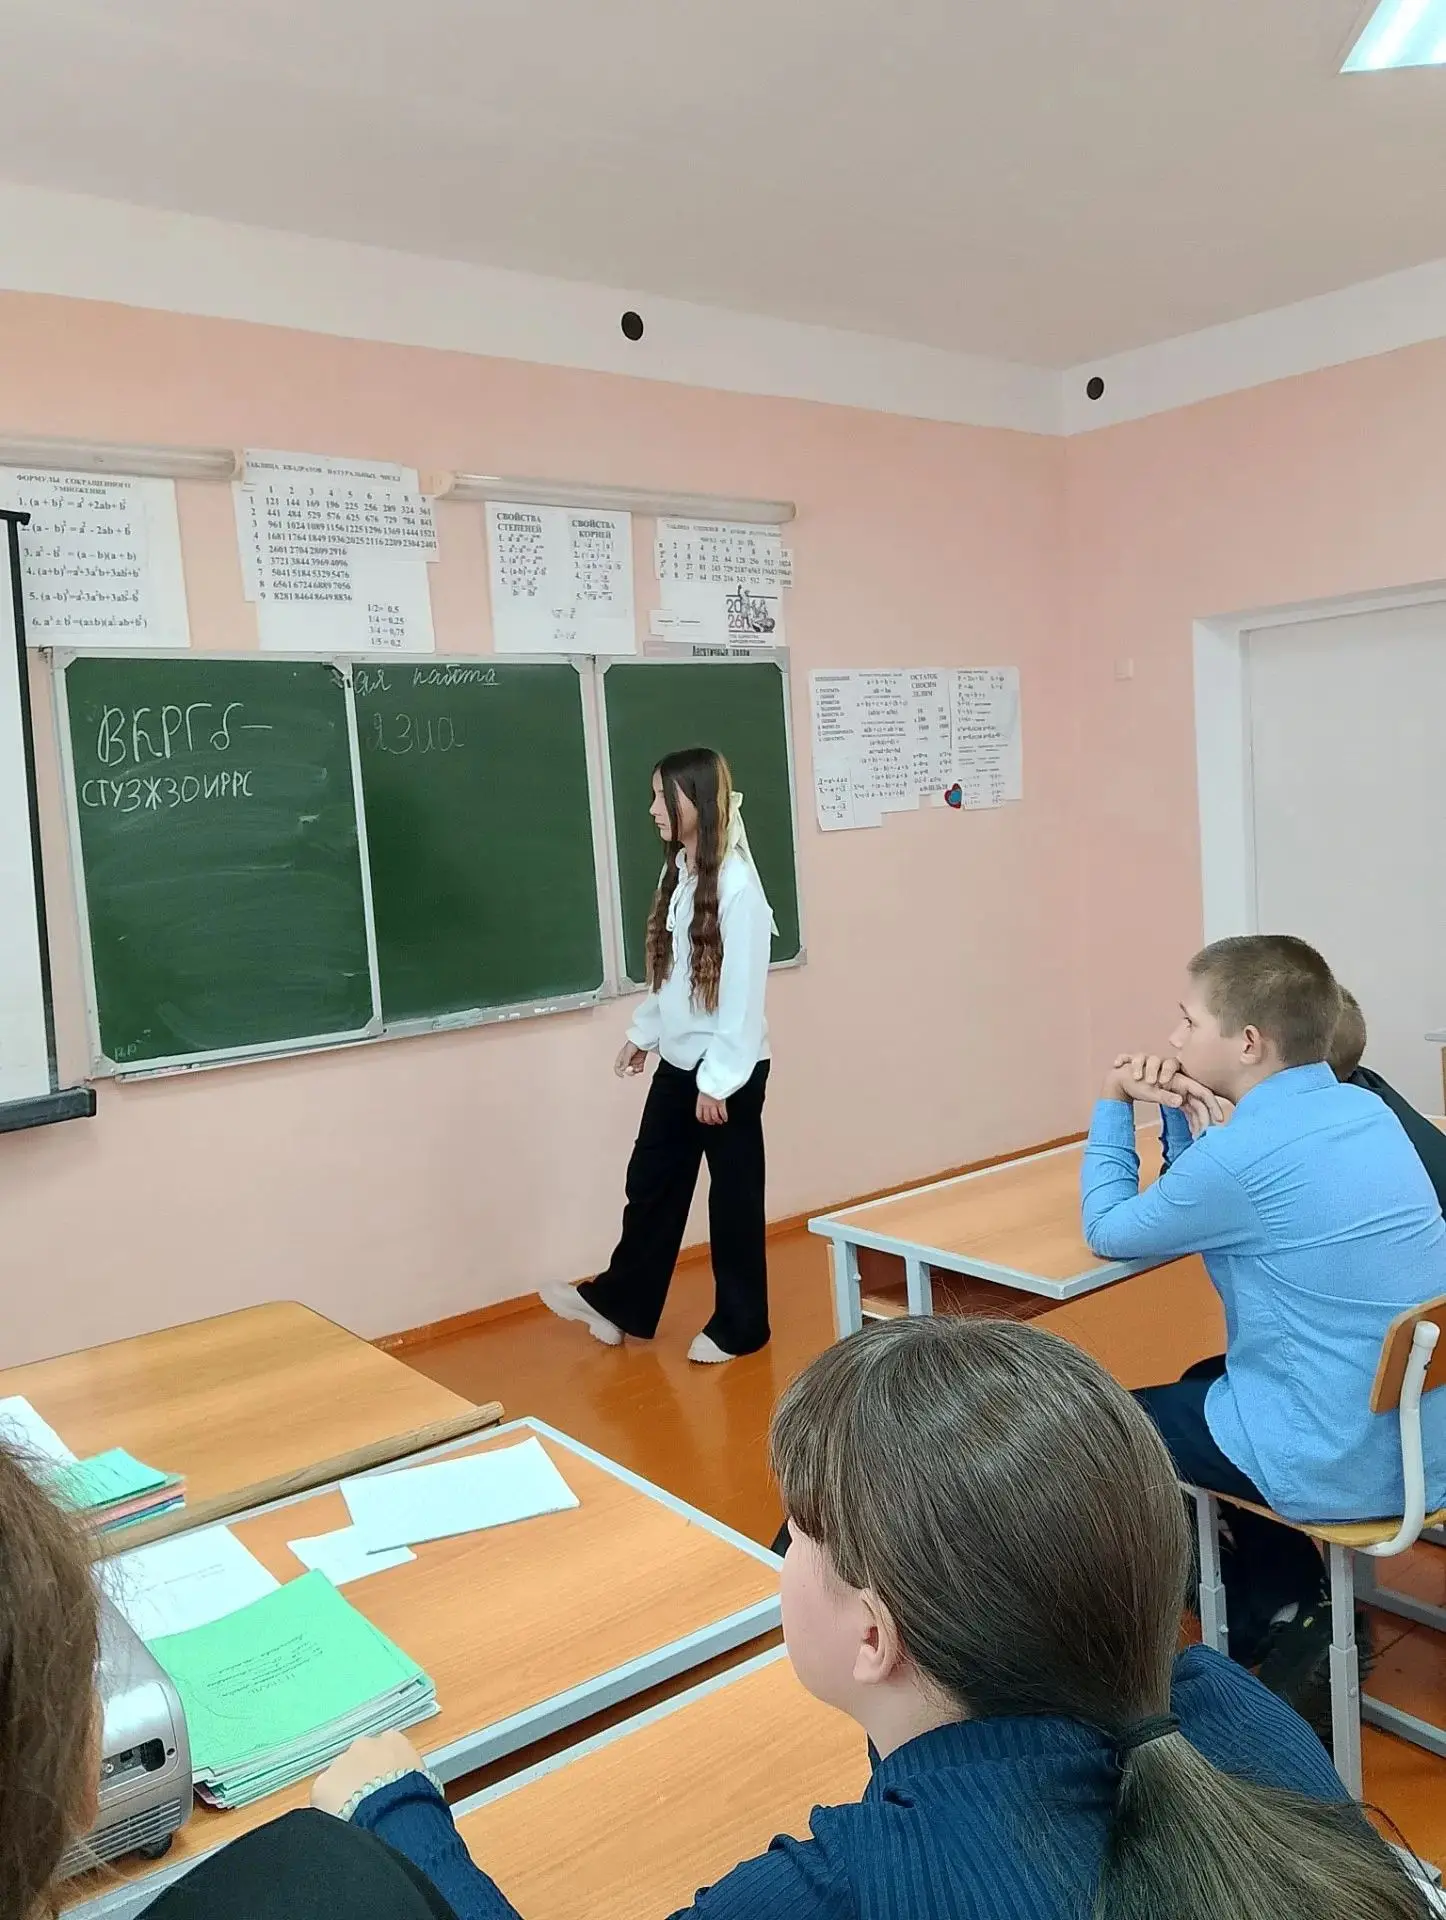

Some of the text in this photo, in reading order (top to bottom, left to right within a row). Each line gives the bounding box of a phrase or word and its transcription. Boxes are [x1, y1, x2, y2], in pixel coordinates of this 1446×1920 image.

[496, 512, 541, 522] СВОЙСТВА
[497, 523, 542, 533] СТЕПЕНЕЙ
[572, 519, 615, 529] СВОЙСТВА
[579, 530, 611, 539] КОРНЕЙ
